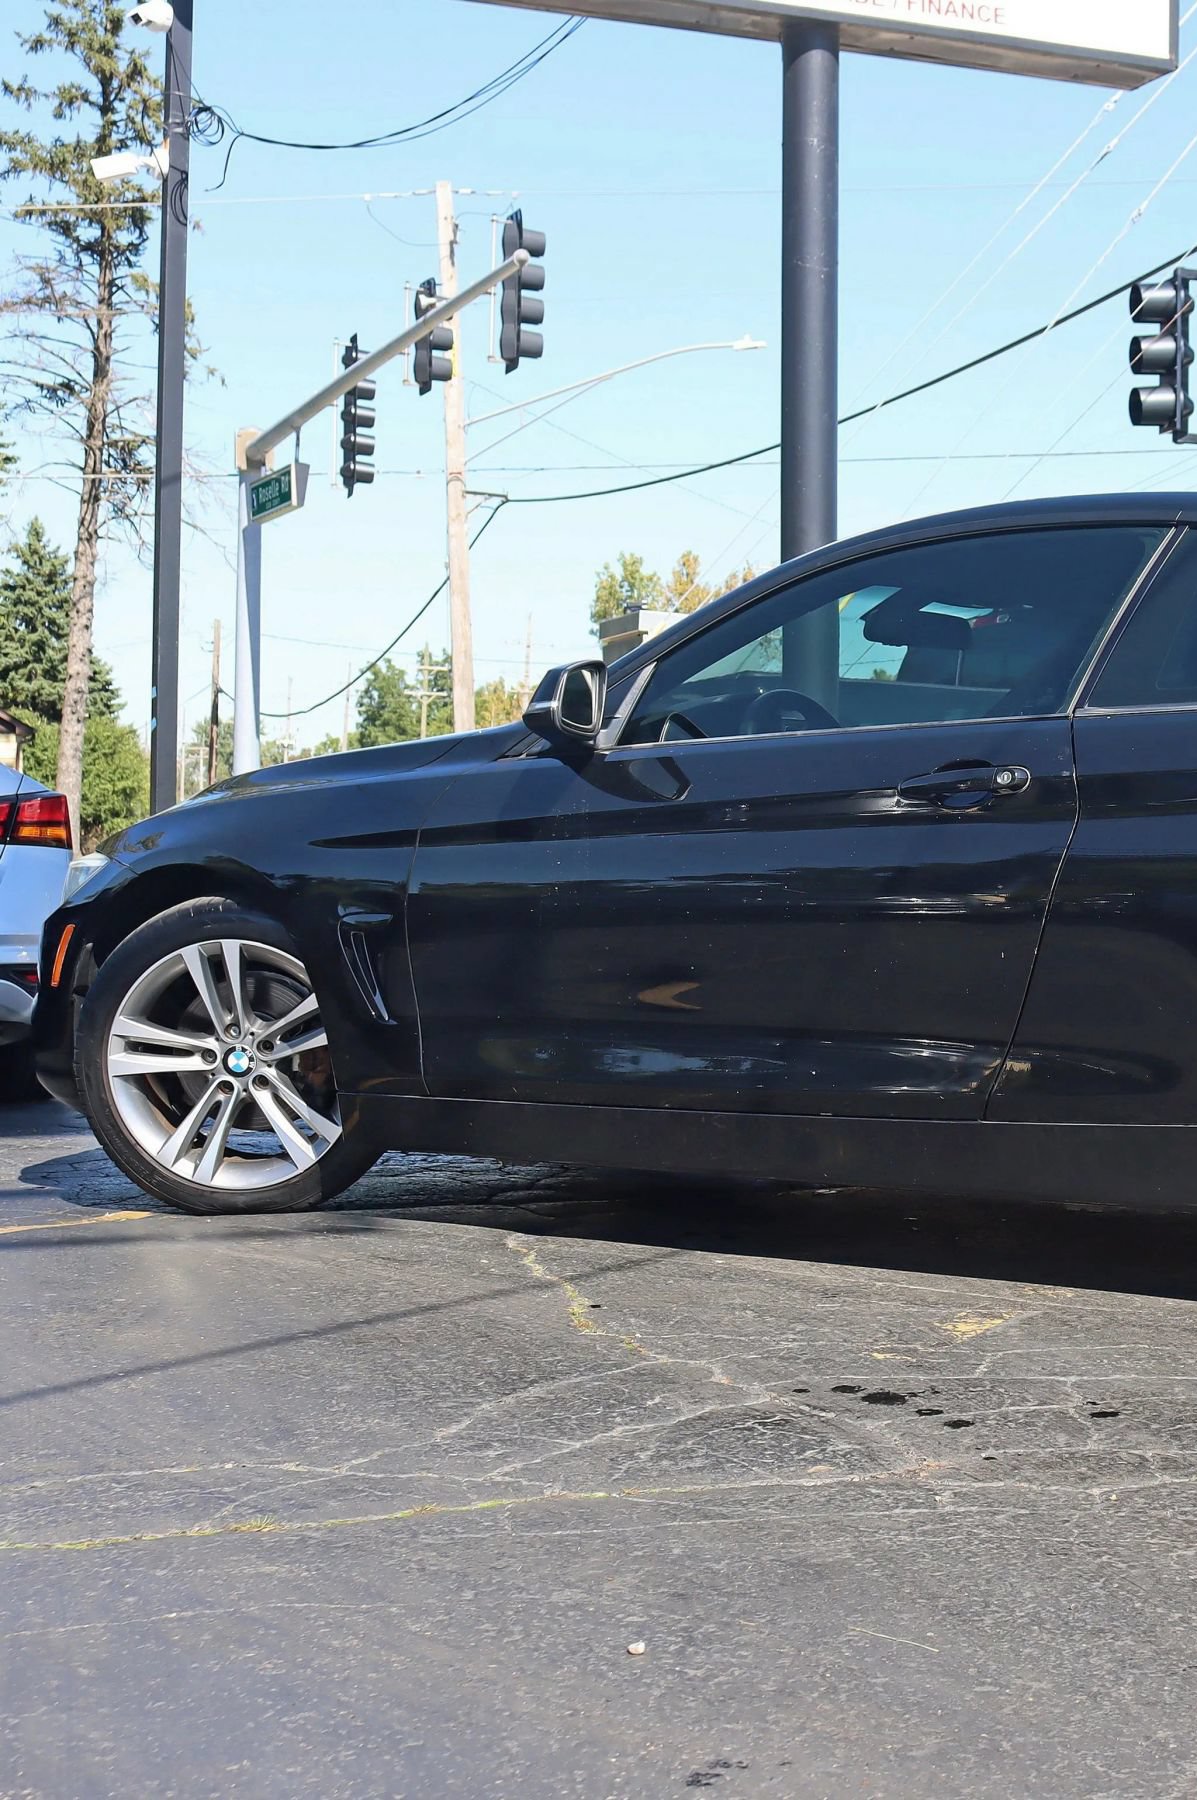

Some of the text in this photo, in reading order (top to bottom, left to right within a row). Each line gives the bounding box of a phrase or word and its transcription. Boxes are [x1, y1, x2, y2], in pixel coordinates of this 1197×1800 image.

[908, 0, 1006, 25] FINANCE
[258, 479, 279, 504] Roselle
[281, 472, 289, 493] Rd
